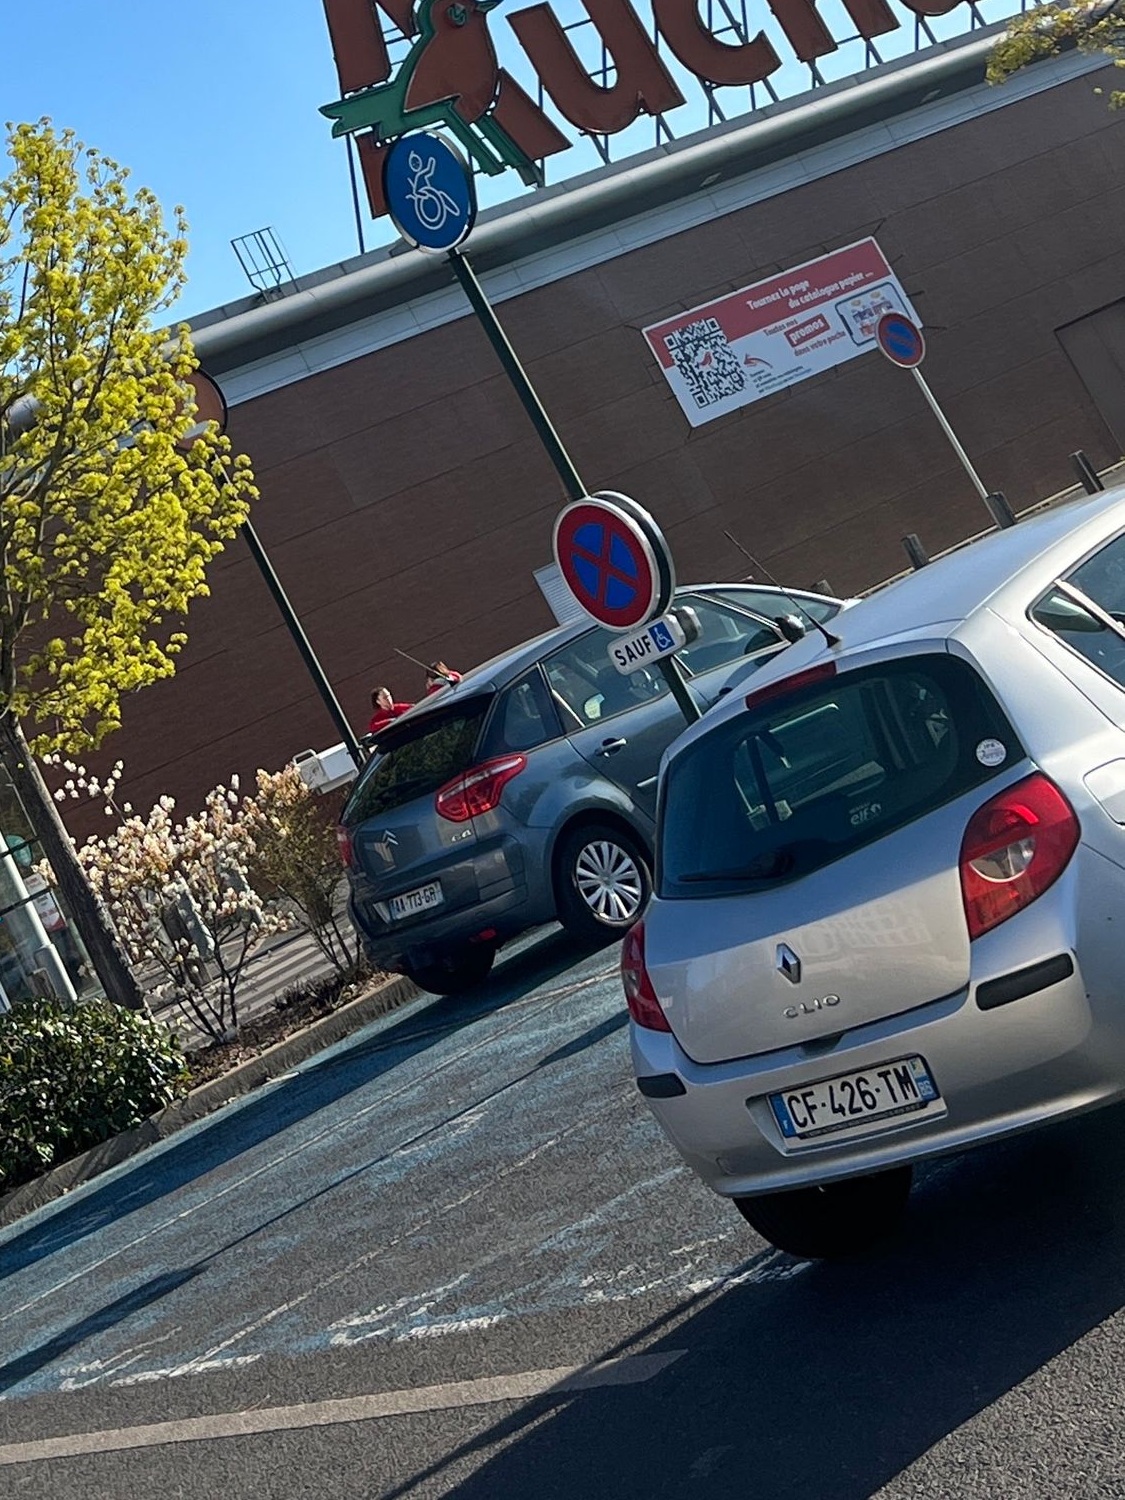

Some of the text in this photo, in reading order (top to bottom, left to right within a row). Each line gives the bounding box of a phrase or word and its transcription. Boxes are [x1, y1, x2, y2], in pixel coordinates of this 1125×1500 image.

[789, 319, 825, 344] promos
[614, 634, 652, 667] SAUF
[783, 993, 841, 1019] CLIO
